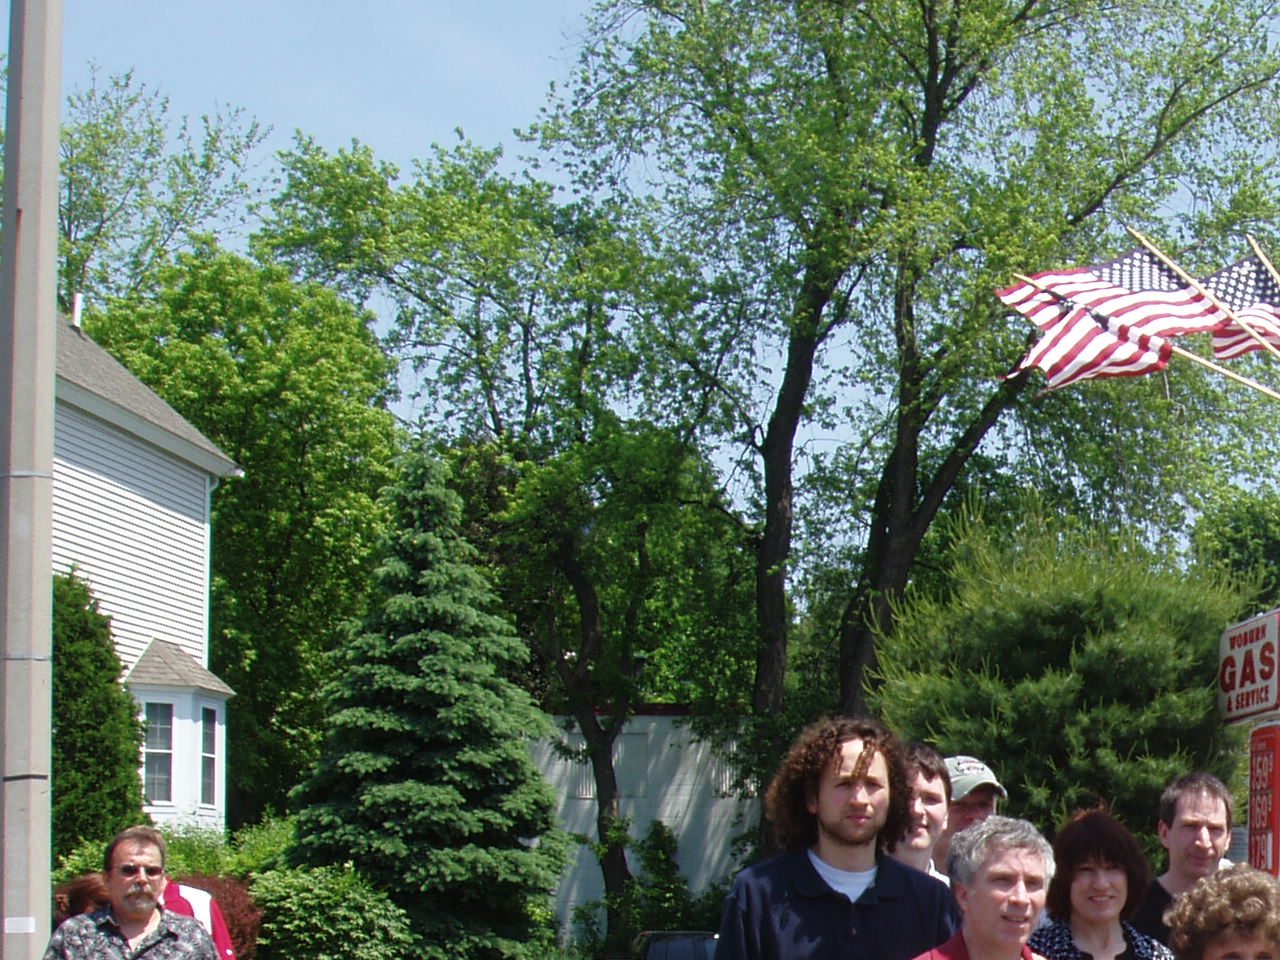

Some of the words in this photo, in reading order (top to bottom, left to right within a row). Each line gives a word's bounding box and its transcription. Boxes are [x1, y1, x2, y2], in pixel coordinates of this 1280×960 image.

[1229, 623, 1267, 650] WOBURN
[1220, 641, 1275, 693] GAS
[1236, 685, 1270, 710] SERVICE
